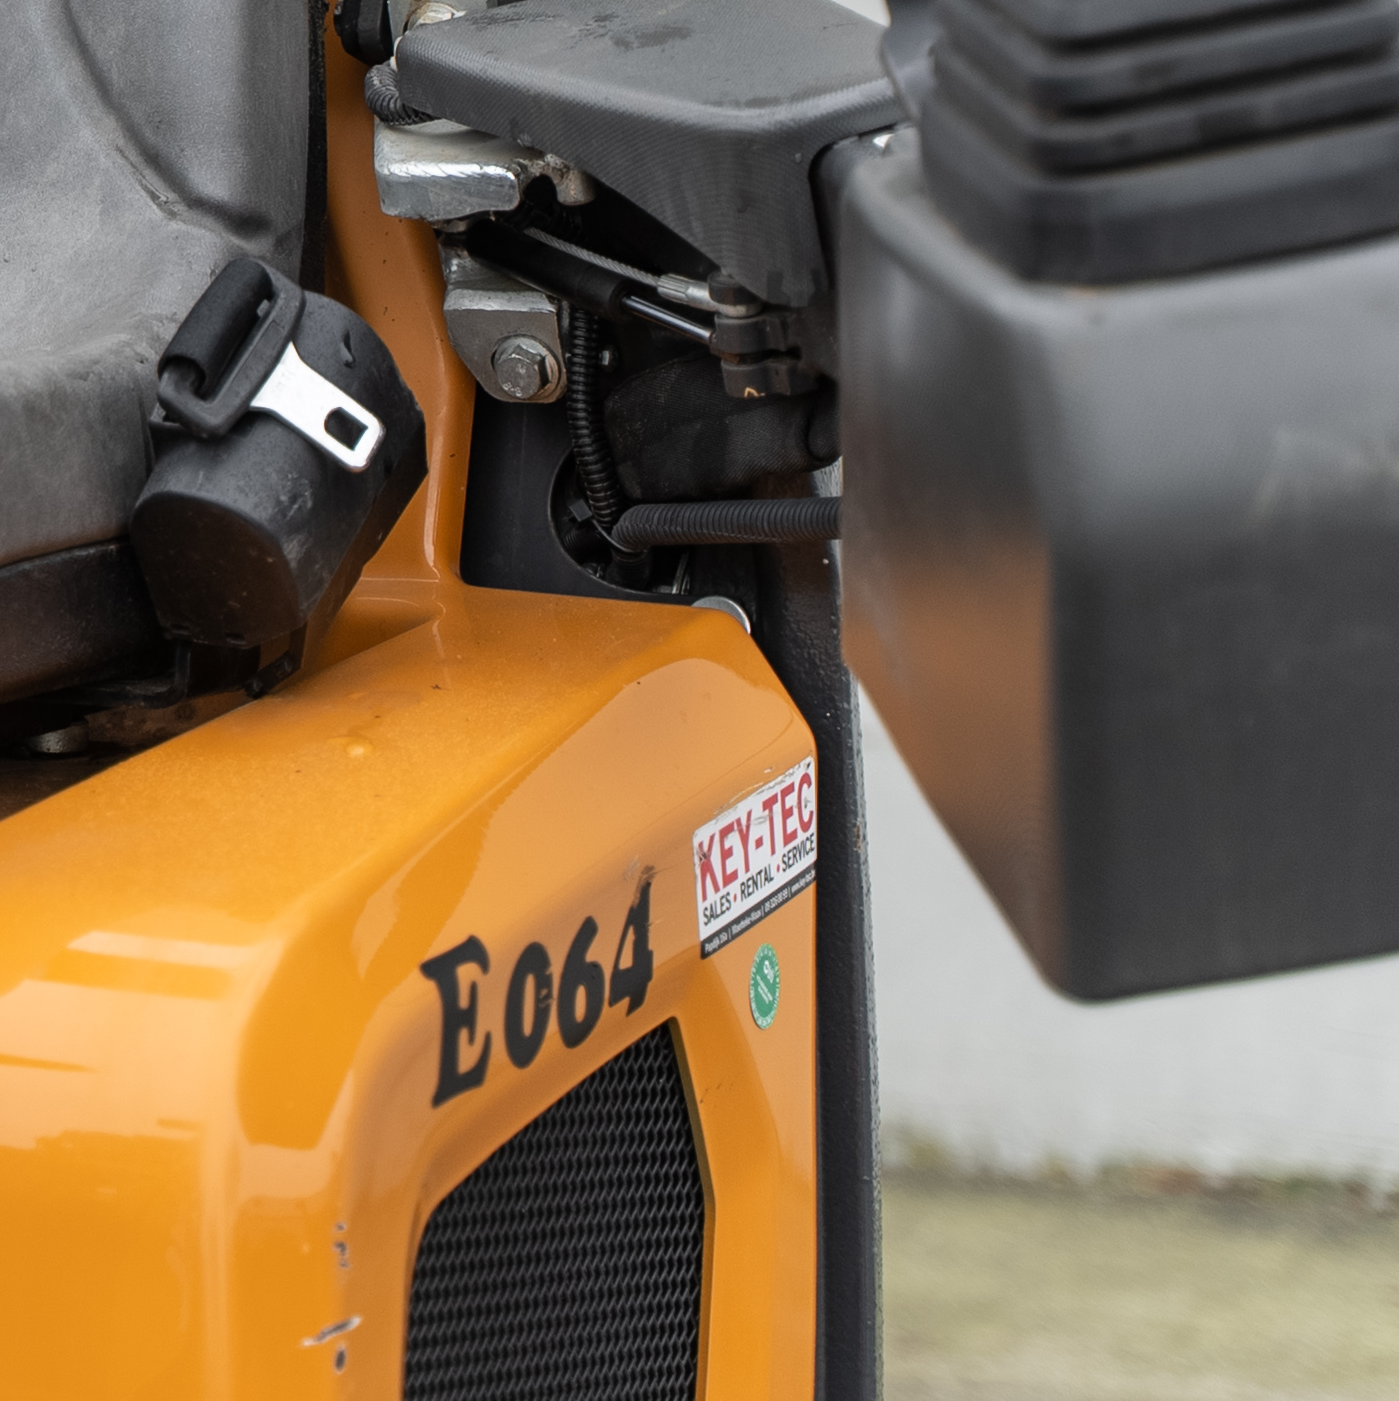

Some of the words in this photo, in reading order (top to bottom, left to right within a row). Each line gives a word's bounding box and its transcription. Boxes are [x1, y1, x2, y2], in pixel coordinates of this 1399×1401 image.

[698, 772, 814, 902] KEY-TEC
[702, 891, 732, 926] SALES
[740, 863, 774, 902] RENTAL
[782, 832, 815, 872] SERVICE
